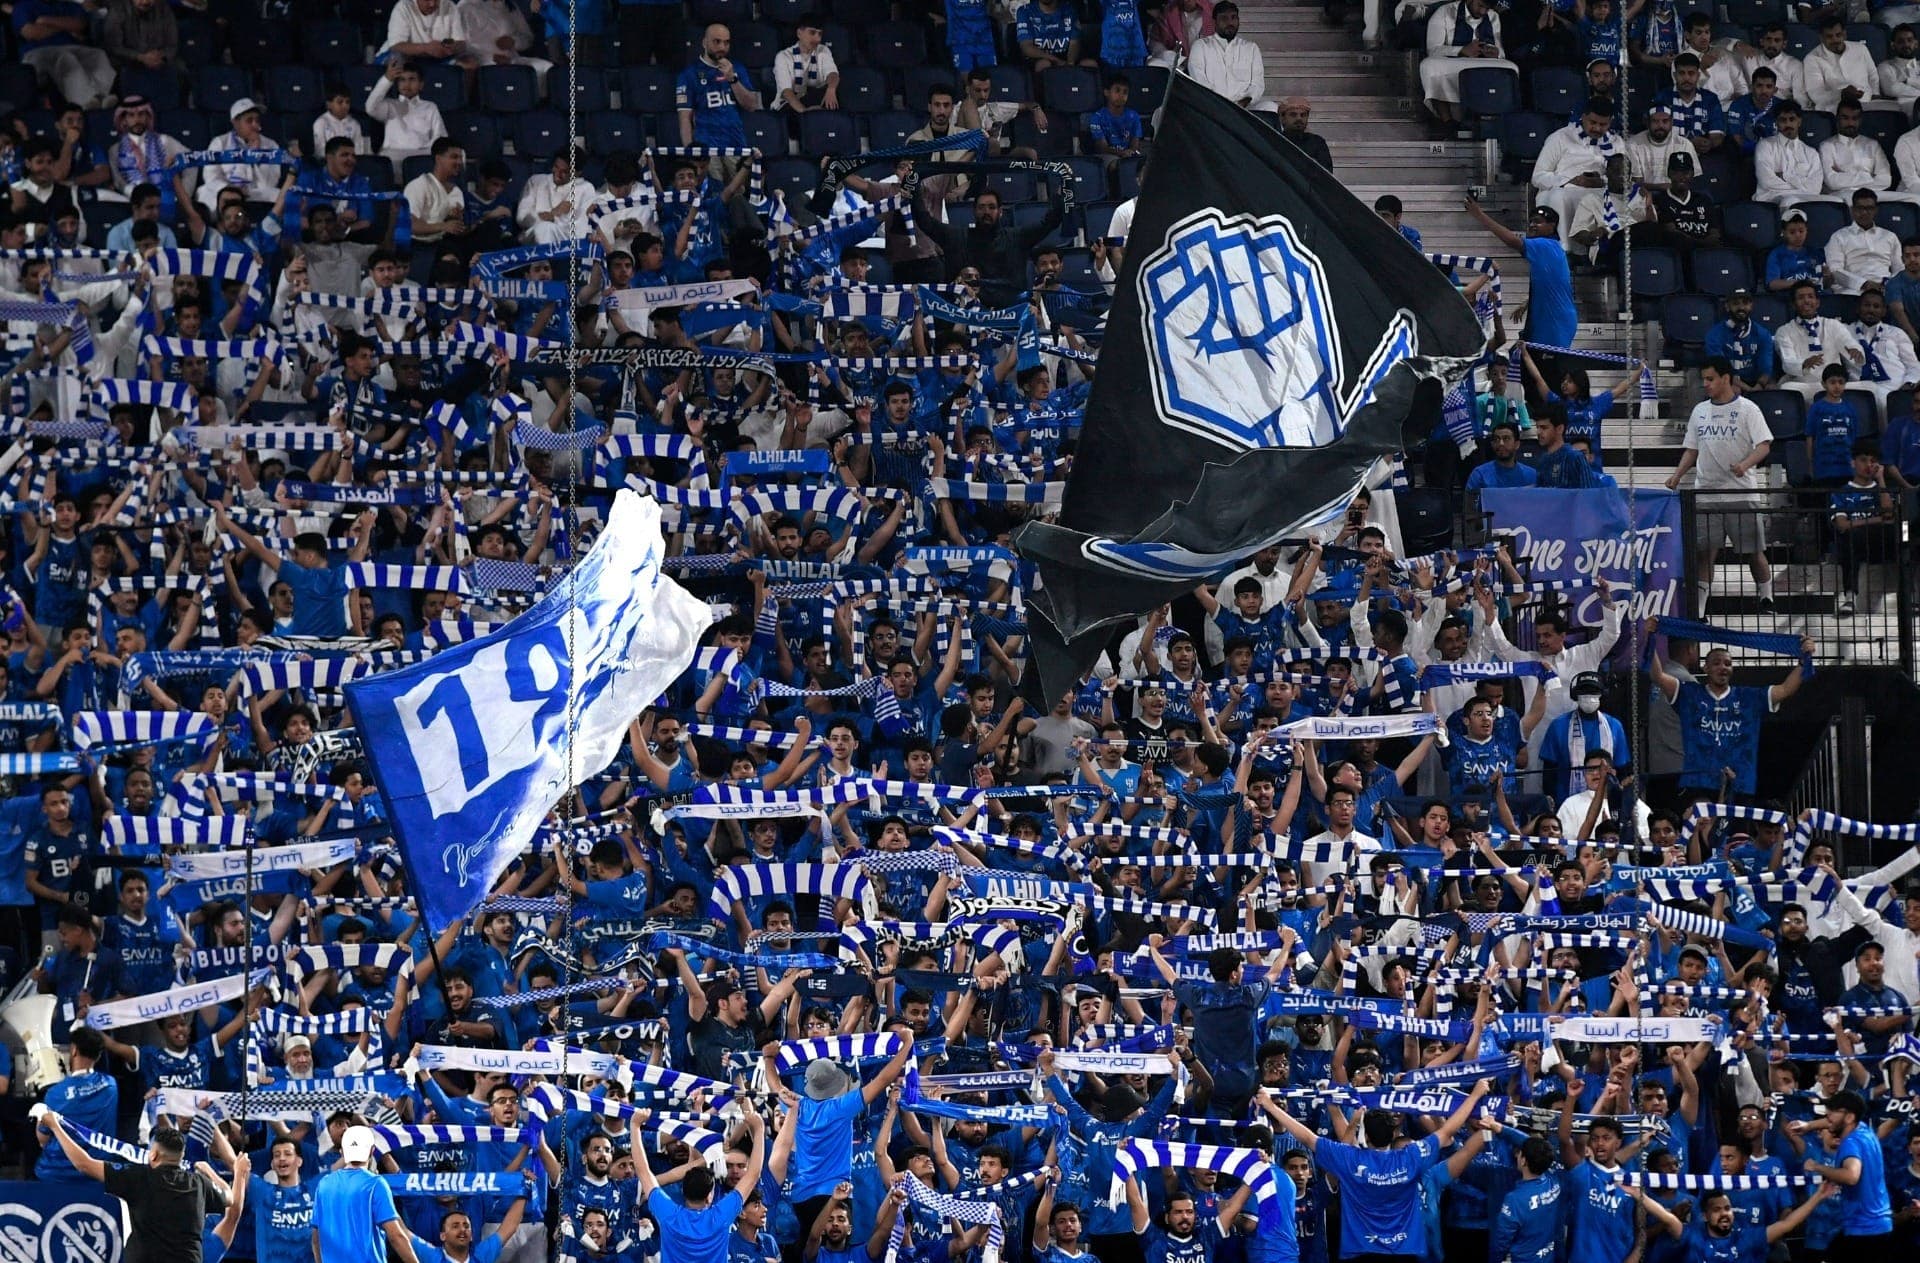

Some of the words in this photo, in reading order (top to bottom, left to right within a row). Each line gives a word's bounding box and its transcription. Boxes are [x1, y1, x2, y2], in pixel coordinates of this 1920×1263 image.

[1698, 426, 1738, 437] SAVVY
[749, 450, 804, 464] ALHILAL
[762, 560, 844, 580] ALHILAL
[1701, 717, 1741, 732] SAVVY
[1464, 761, 1509, 774] SAVVY
[1584, 916, 1631, 929] الهلال
[1188, 931, 1268, 951] ALHILAL
[122, 948, 162, 961] SAVVY
[1371, 1012, 1450, 1036] ALHILAL
[960, 1073, 1030, 1085] ALHILAL
[1413, 1063, 1485, 1085] ALHILAL
[1380, 1091, 1453, 1112] الهلال
[418, 1150, 465, 1164] SAVVY
[406, 1172, 500, 1192] ALHILAL
